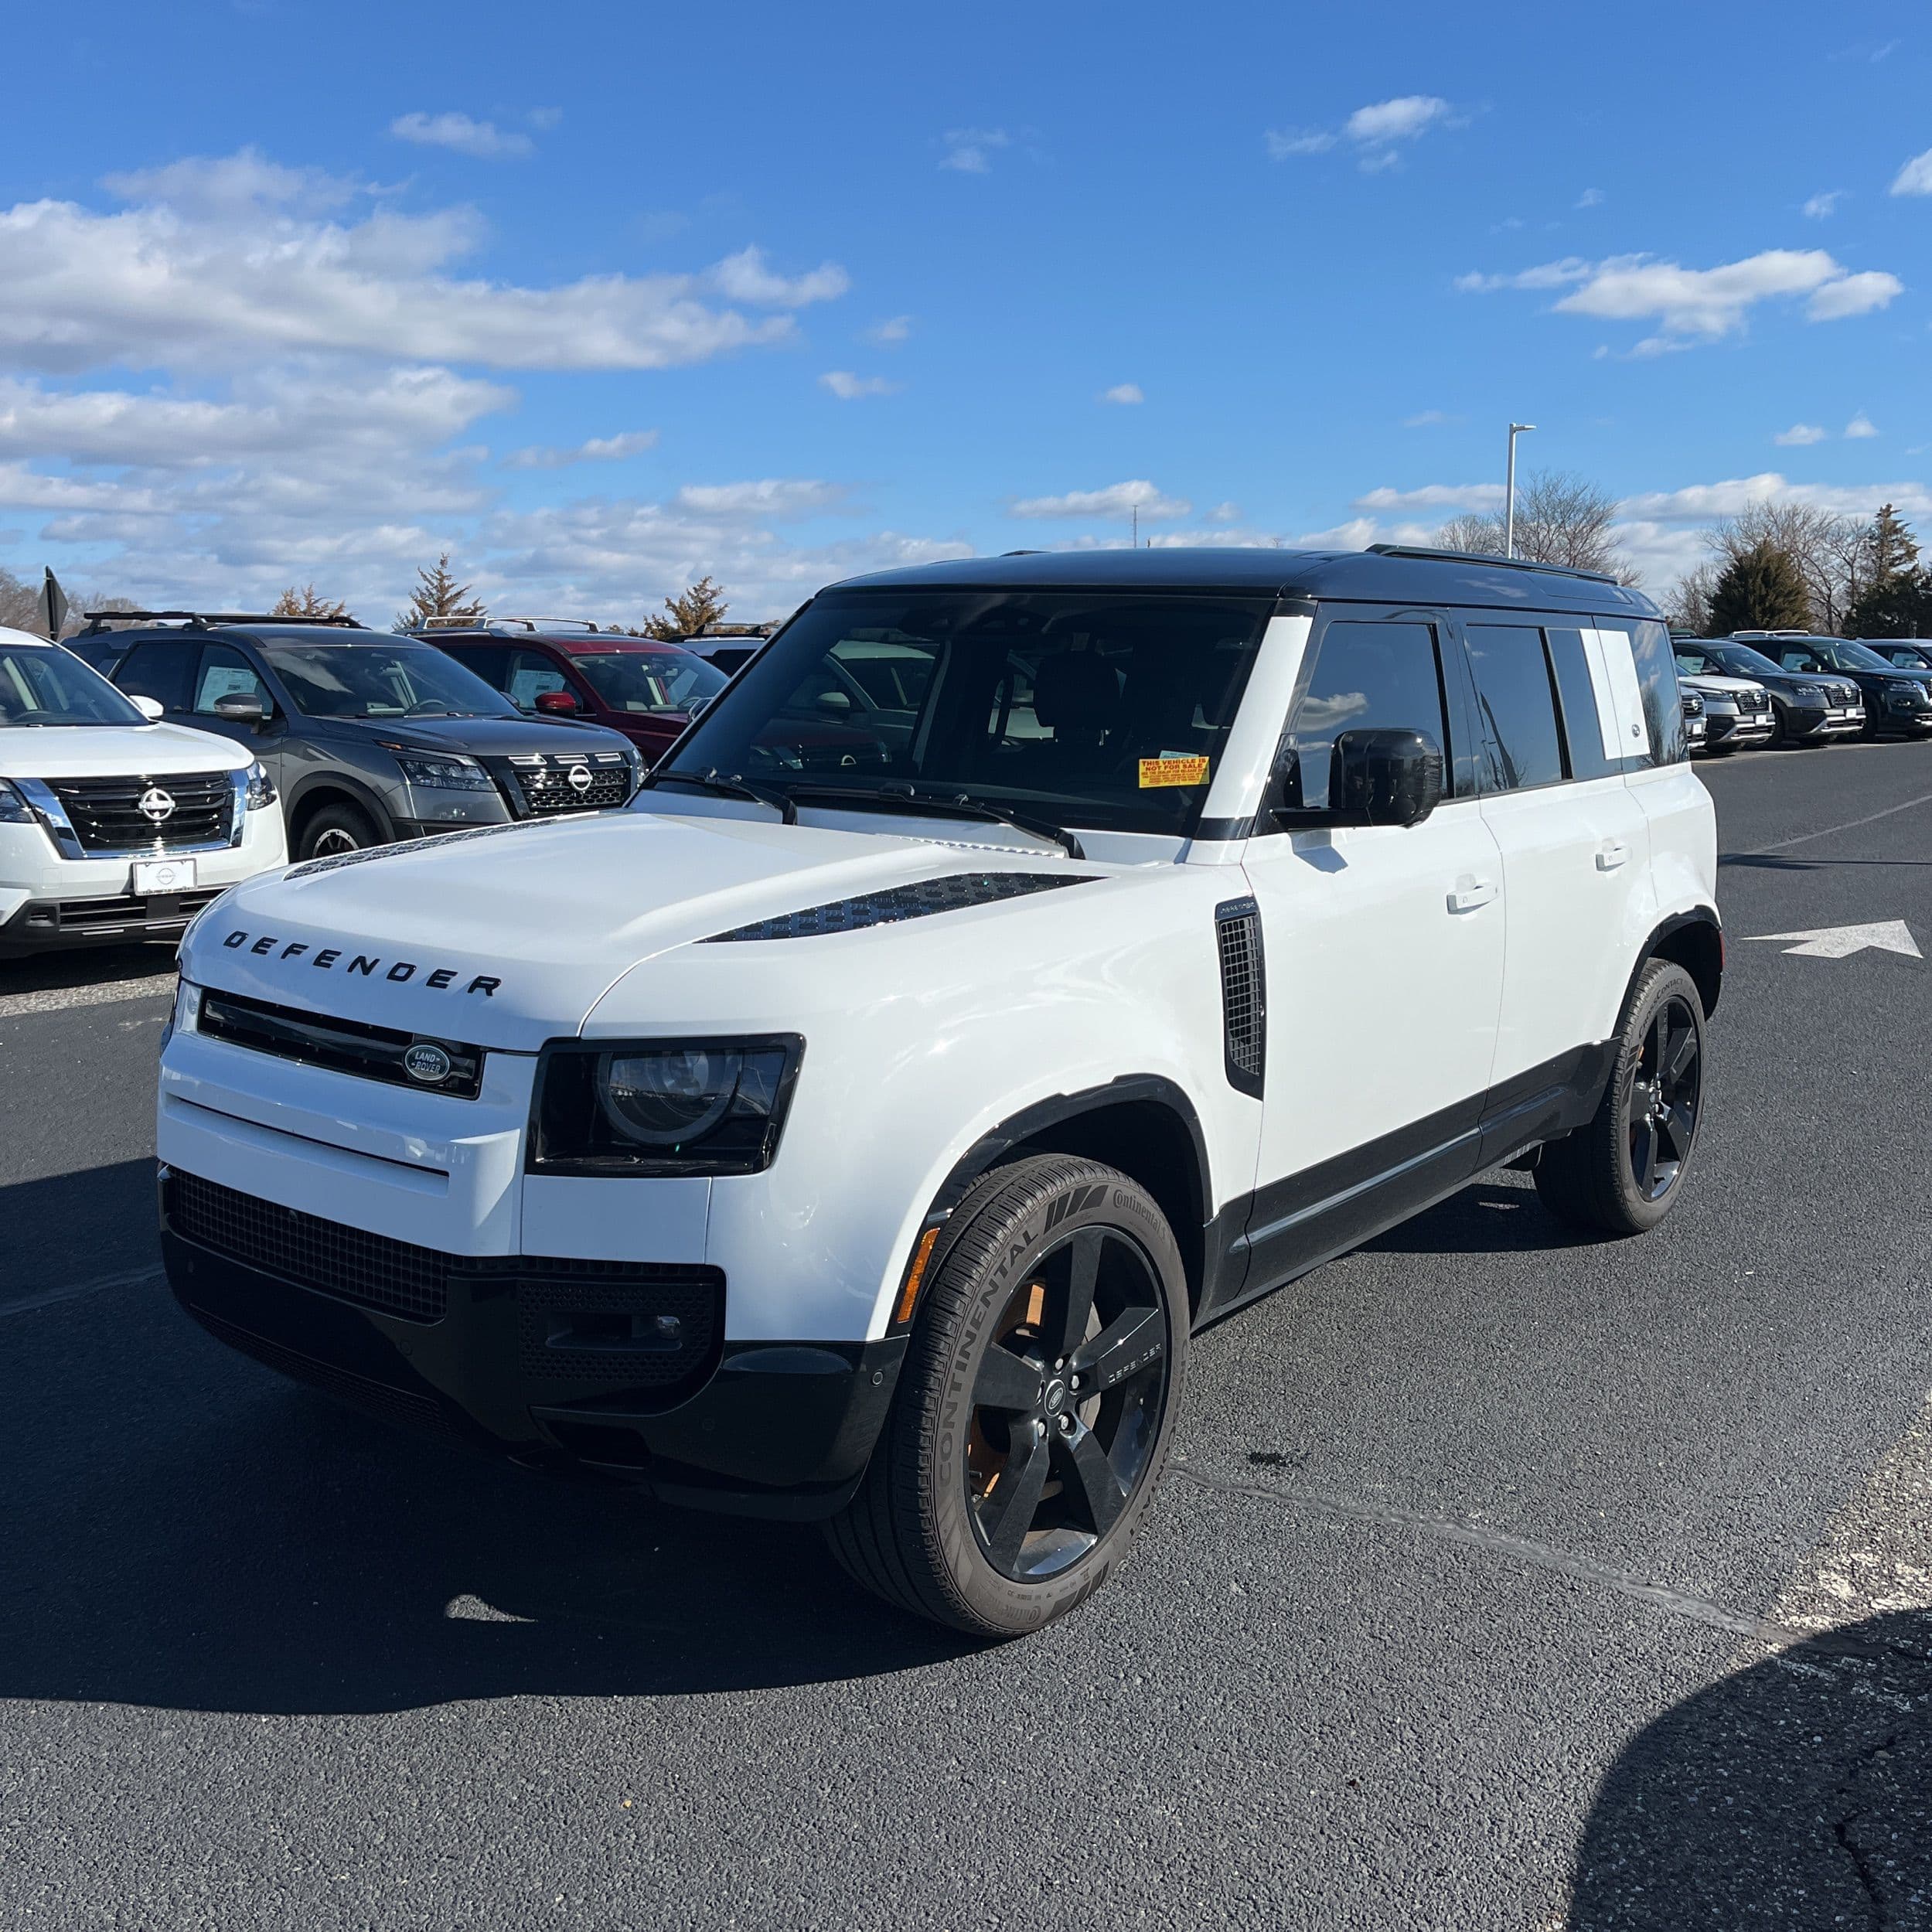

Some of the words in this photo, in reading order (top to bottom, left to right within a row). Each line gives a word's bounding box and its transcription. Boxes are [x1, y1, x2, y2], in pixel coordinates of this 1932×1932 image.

[223, 930, 501, 997] DEFENDER
[414, 1051, 435, 1063] LAND
[414, 1061, 441, 1074] ROVER
[1113, 1189, 1161, 1235] Continental
[938, 1232, 1038, 1487] CONTINENTAL
[1108, 1343, 1162, 1384] DEFENDER
